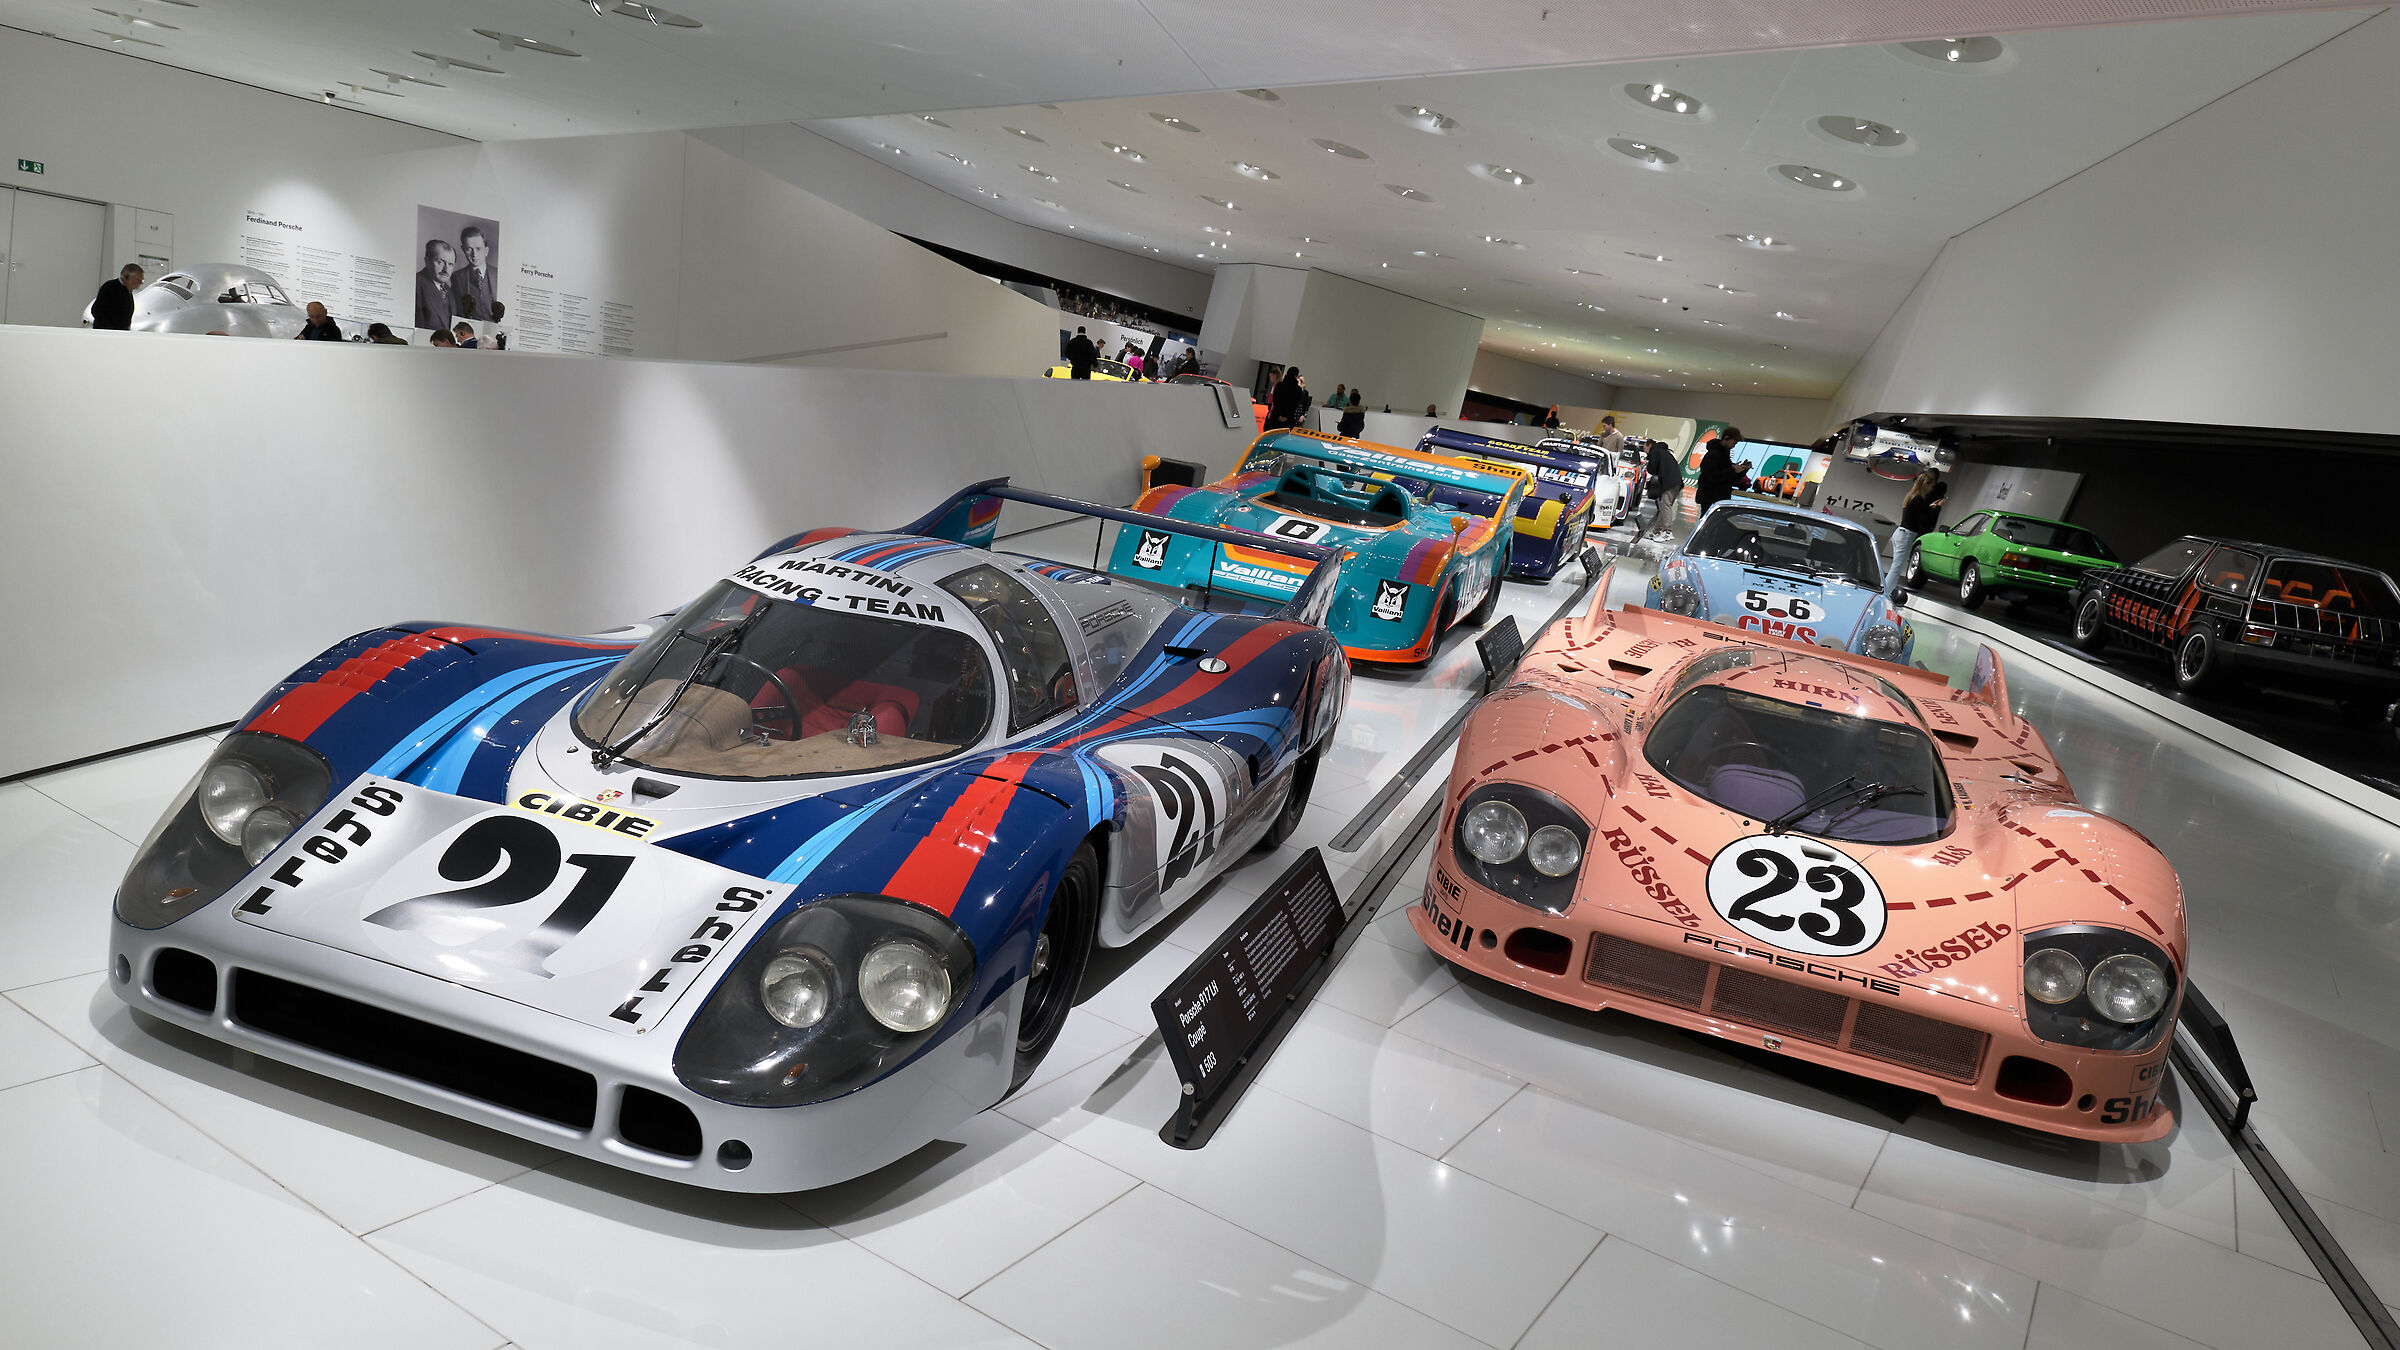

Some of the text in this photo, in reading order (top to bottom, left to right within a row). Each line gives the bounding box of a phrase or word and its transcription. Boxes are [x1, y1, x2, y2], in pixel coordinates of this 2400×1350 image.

[246, 215, 302, 231] Ferdinand Porsche
[520, 267, 553, 279] Ferry Porsche
[1120, 334, 1144, 345] Persönlich
[1295, 428, 1344, 442] Shell
[1487, 440, 1549, 456] GOODYEAR
[1320, 441, 1481, 479] Vaillant
[1472, 462, 1522, 477] Shell
[1134, 553, 1163, 567] Vaillant
[1220, 561, 1305, 587] Vaillan
[777, 559, 915, 598] MARTINI
[1080, 602, 1136, 633] PORSCHE
[1373, 606, 1404, 618] Vaillant
[1737, 615, 1818, 646] CWS
[1772, 678, 1860, 705] HIRN
[1632, 771, 1673, 800] HAL
[1130, 752, 1216, 896] 21
[1436, 868, 1462, 902] CIBIE
[1601, 826, 1705, 929] RÜSSEL
[362, 815, 636, 980] 21
[1727, 848, 1866, 947] 23
[1423, 881, 1474, 953] Shell
[1683, 932, 1901, 997] PORSCHE
[1876, 920, 2013, 980] RÜSSEL
[1179, 979, 1219, 1028] Porsche 917 LH
[1187, 1020, 1207, 1048] Coupé
[1203, 1051, 1217, 1073] 503
